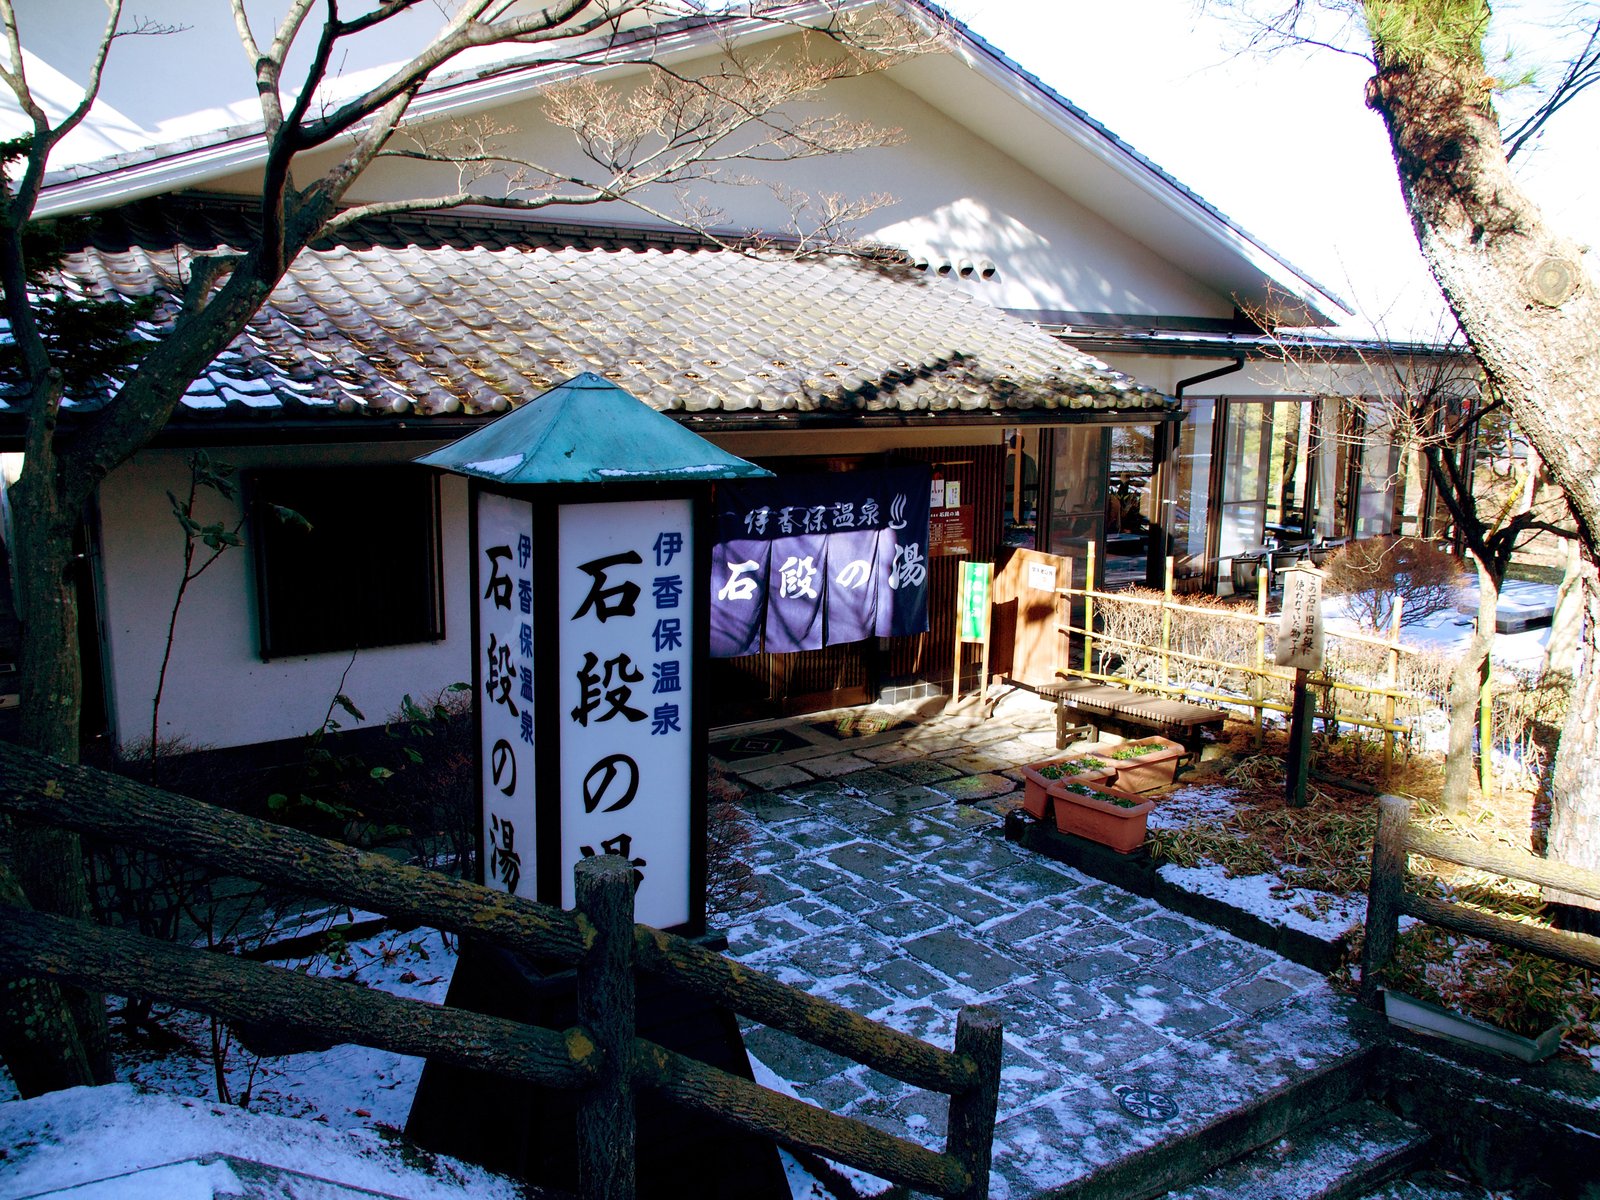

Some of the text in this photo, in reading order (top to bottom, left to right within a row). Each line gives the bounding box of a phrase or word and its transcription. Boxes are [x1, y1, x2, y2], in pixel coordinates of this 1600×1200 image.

[718, 542, 926, 601] 石段の湯
[744, 498, 880, 535] 伊香保温泉
[484, 545, 521, 894] 石段の湯
[517, 533, 534, 747] 伊香保温泉
[651, 532, 683, 736] 伊香保温泉
